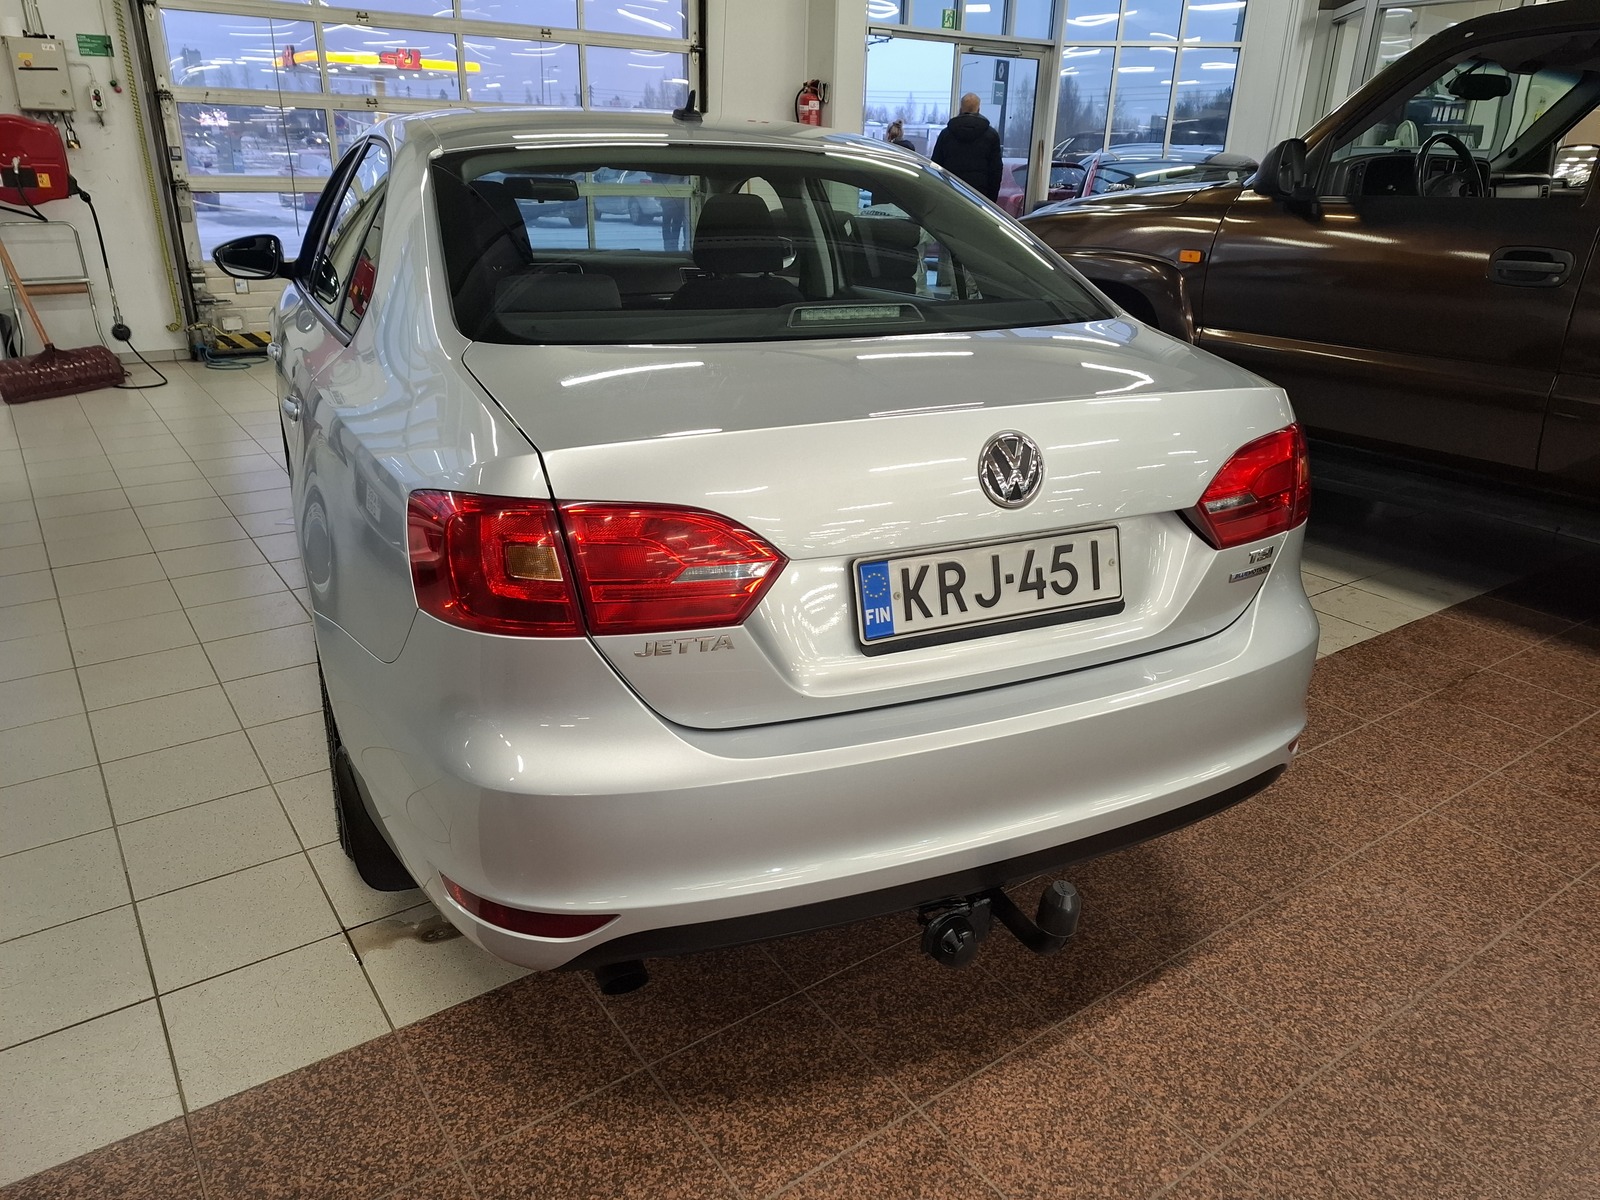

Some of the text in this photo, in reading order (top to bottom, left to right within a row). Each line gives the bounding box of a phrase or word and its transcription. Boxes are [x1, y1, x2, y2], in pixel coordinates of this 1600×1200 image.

[901, 540, 1100, 622] KRJ-451
[866, 606, 891, 626] FIN
[634, 634, 735, 657] JETTA
